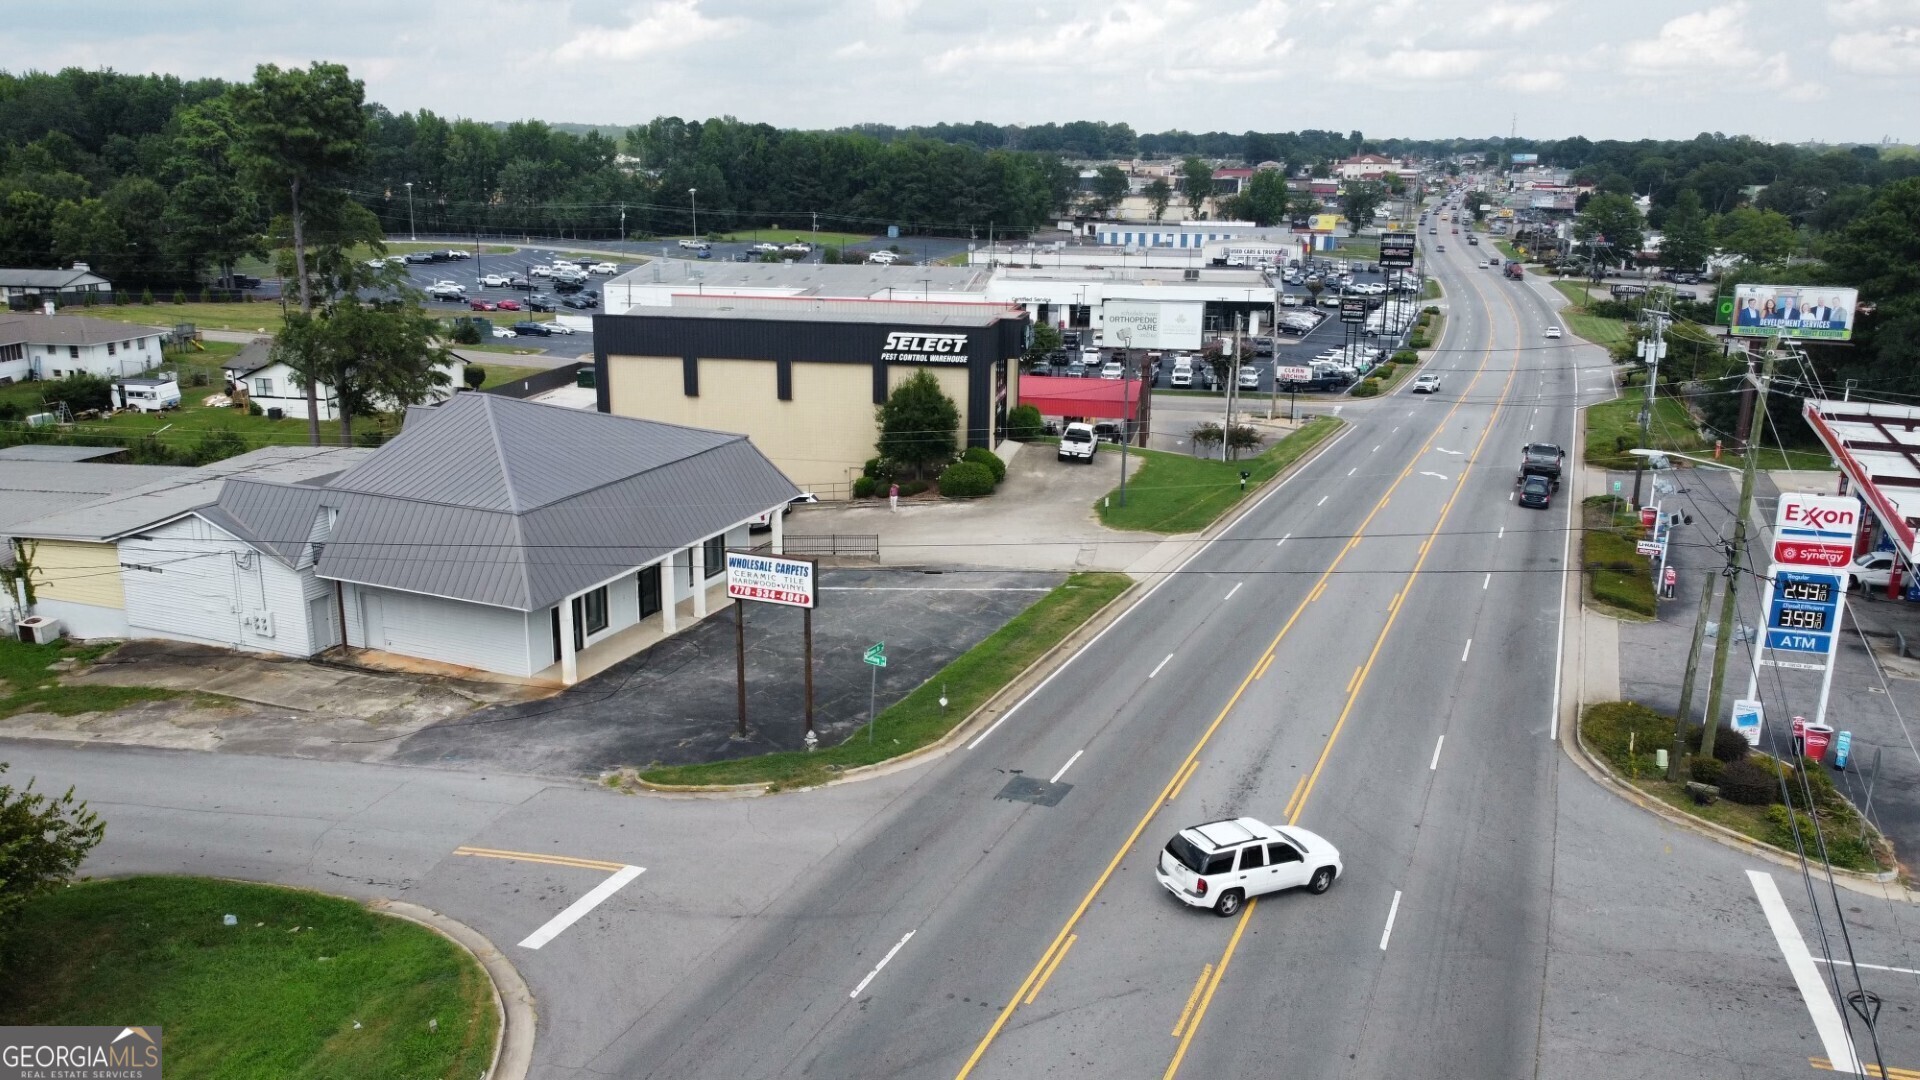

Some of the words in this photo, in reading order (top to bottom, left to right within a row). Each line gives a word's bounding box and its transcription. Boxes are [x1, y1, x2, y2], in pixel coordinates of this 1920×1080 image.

[1109, 316, 1157, 324] ORTHOPEDIC
[1760, 318, 1801, 327] DEVELOPMENT
[1802, 319, 1831, 329] SERVICES
[883, 331, 968, 353] SELECT
[881, 352, 897, 361] PEST
[898, 353, 928, 362] CONTROL
[929, 354, 968, 363] WAREHOUSE
[1785, 504, 1854, 529] Exxon
[1800, 549, 1844, 563] Synergy
[728, 557, 772, 573] WHOLESALE
[775, 562, 809, 578] CARPETS
[733, 570, 777, 581] CERAMIC
[783, 576, 804, 585] TILE
[733, 585, 806, 604] 770-534-4041
[1780, 635, 1816, 649] ATM
